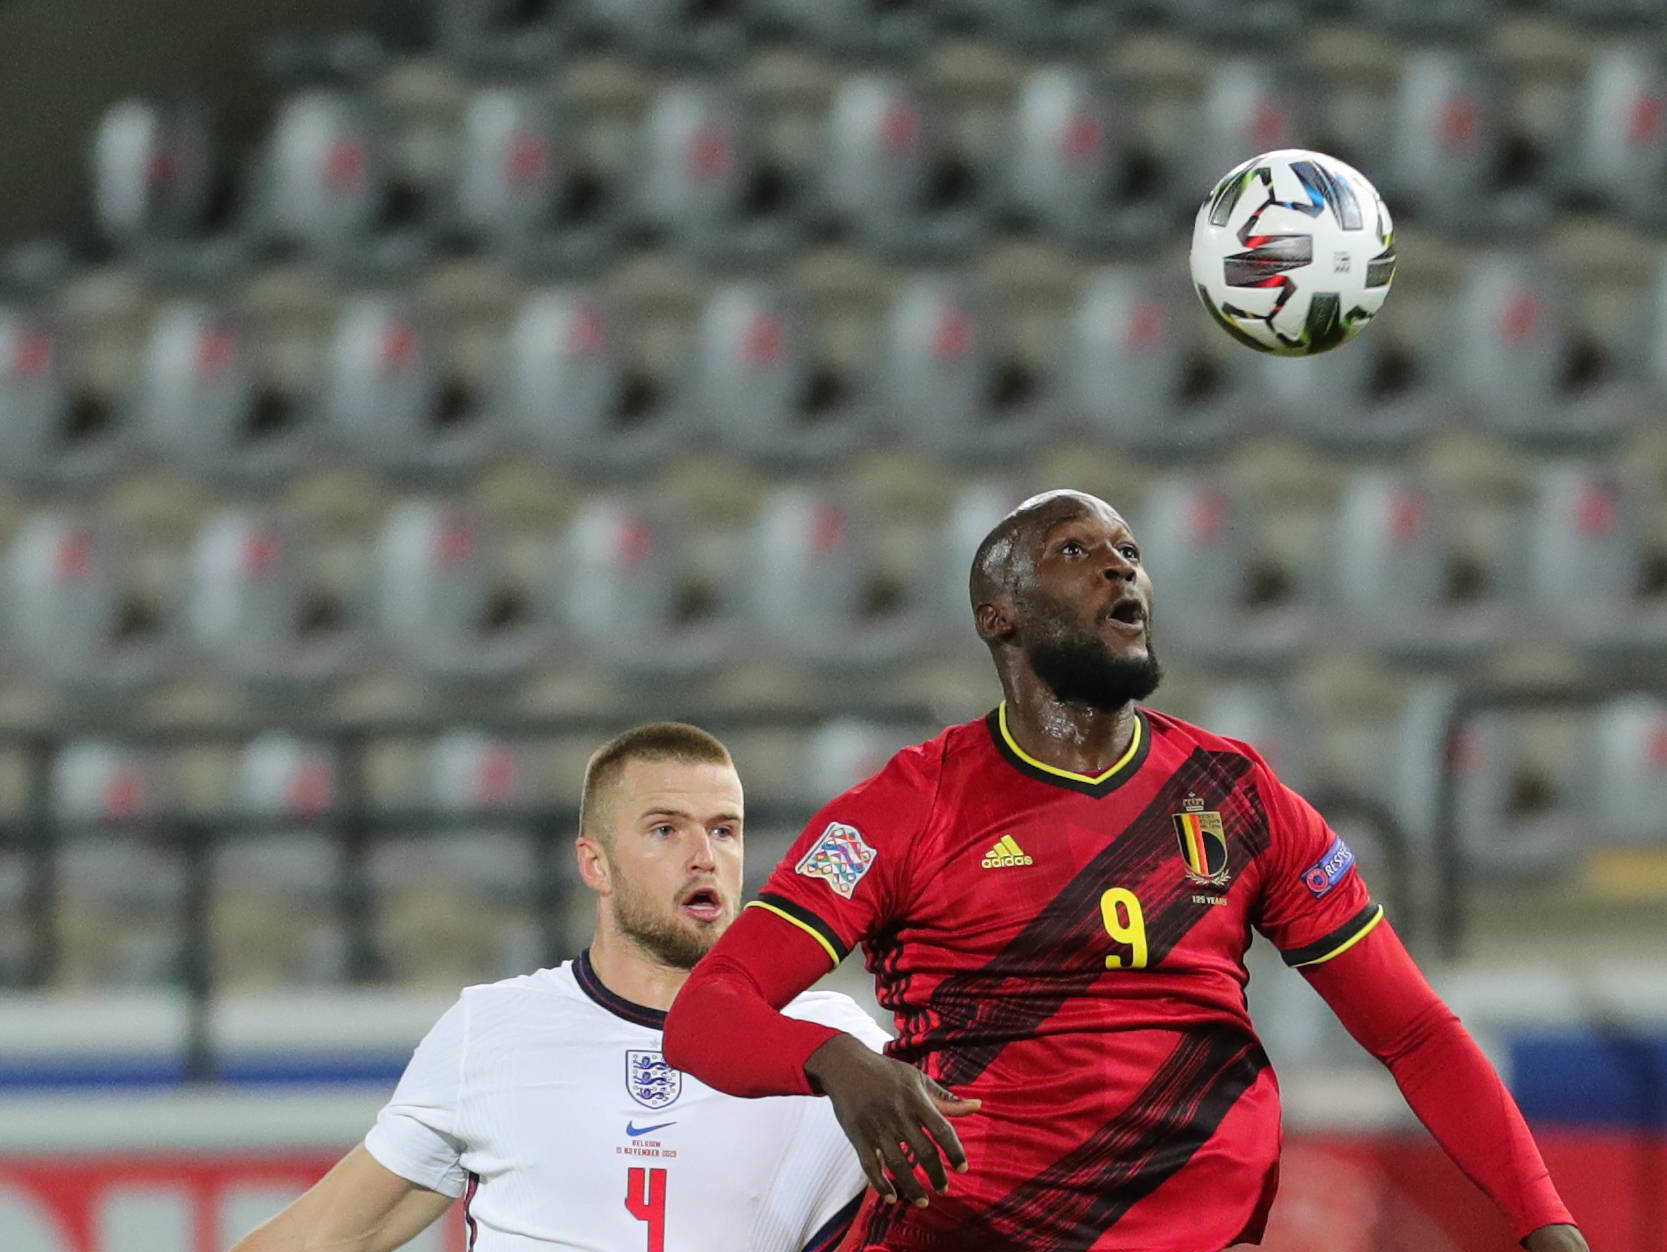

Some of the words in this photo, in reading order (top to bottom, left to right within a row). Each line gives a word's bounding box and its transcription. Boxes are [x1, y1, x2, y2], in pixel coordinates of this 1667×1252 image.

[981, 854, 1034, 869] adidas
[1207, 896, 1228, 906] YEARS
[1101, 887, 1149, 969] 9
